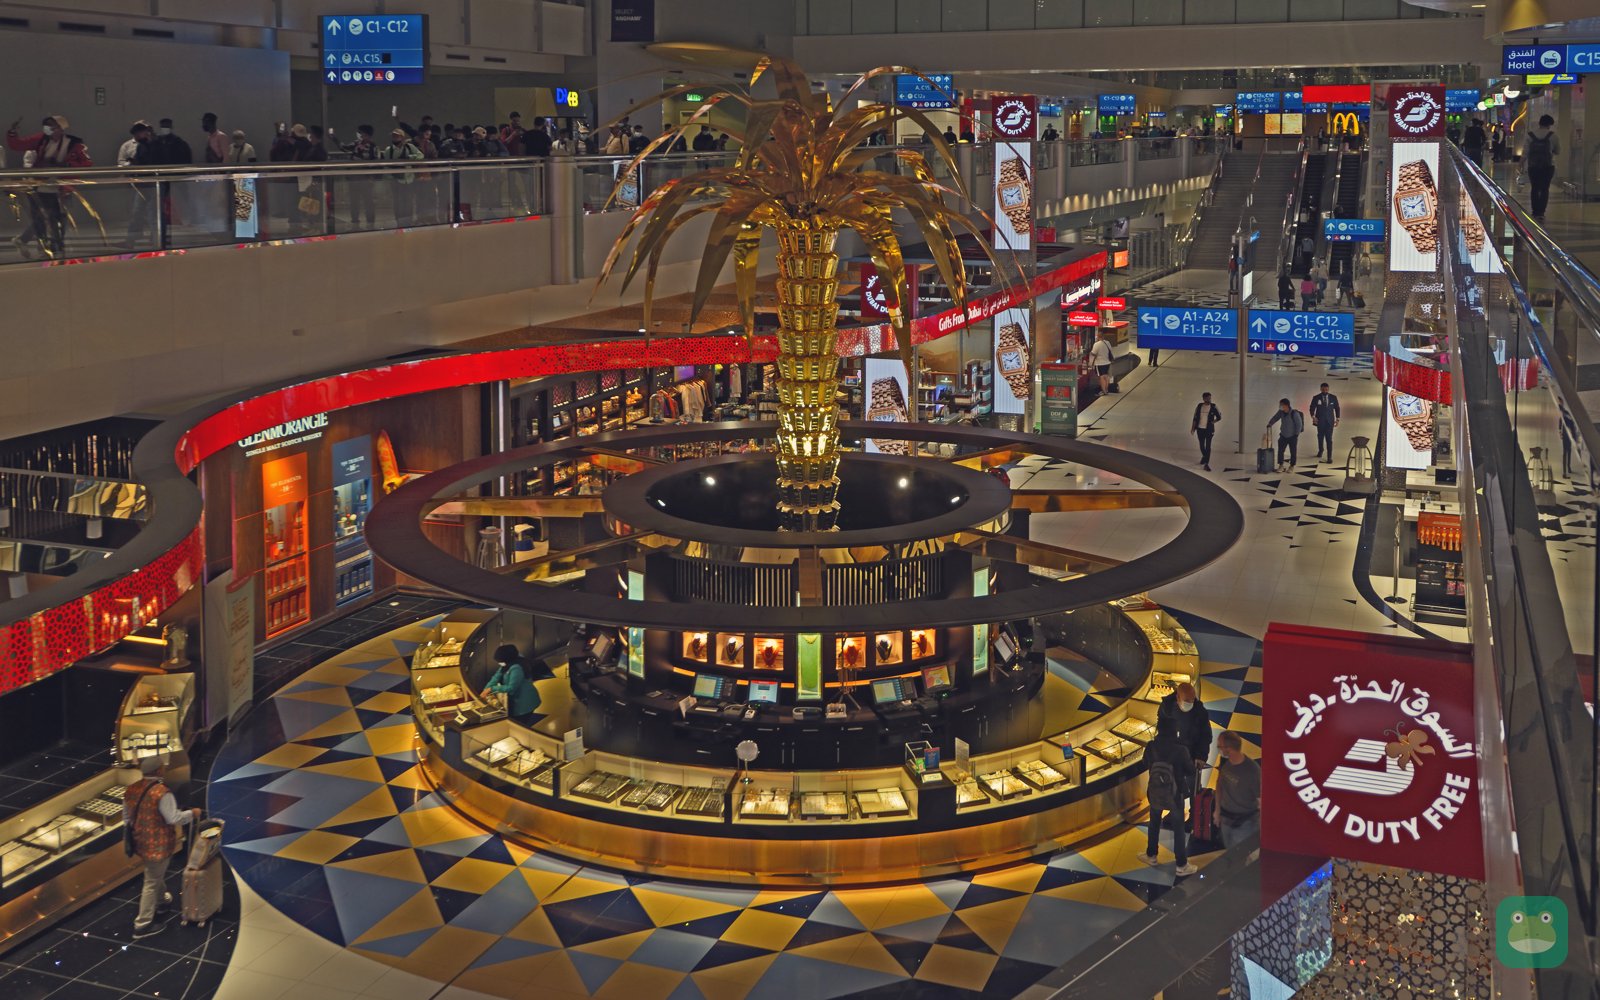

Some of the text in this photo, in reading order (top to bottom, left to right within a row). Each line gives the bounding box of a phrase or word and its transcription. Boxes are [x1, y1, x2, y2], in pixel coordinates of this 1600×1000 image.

[366, 20, 409, 33] C1-C12
[1508, 49, 1536, 60] الفندق
[1508, 61, 1535, 69] Hotel
[1393, 112, 1441, 133] DUBAI DUTY FREE
[1348, 223, 1375, 231] C1-C13
[865, 291, 880, 310] DUBAI
[1182, 311, 1230, 323] A1-A24
[1293, 315, 1339, 327] C1-C12
[938, 316, 952, 332] Gifts
[1182, 324, 1222, 335] F1-F12
[245, 446, 266, 457] SINGLE
[266, 442, 281, 452] MALT
[280, 437, 302, 448] SCOTCH
[1400, 687, 1475, 758] السوق
[1282, 752, 1471, 844] DUBAI DUTY FREE
